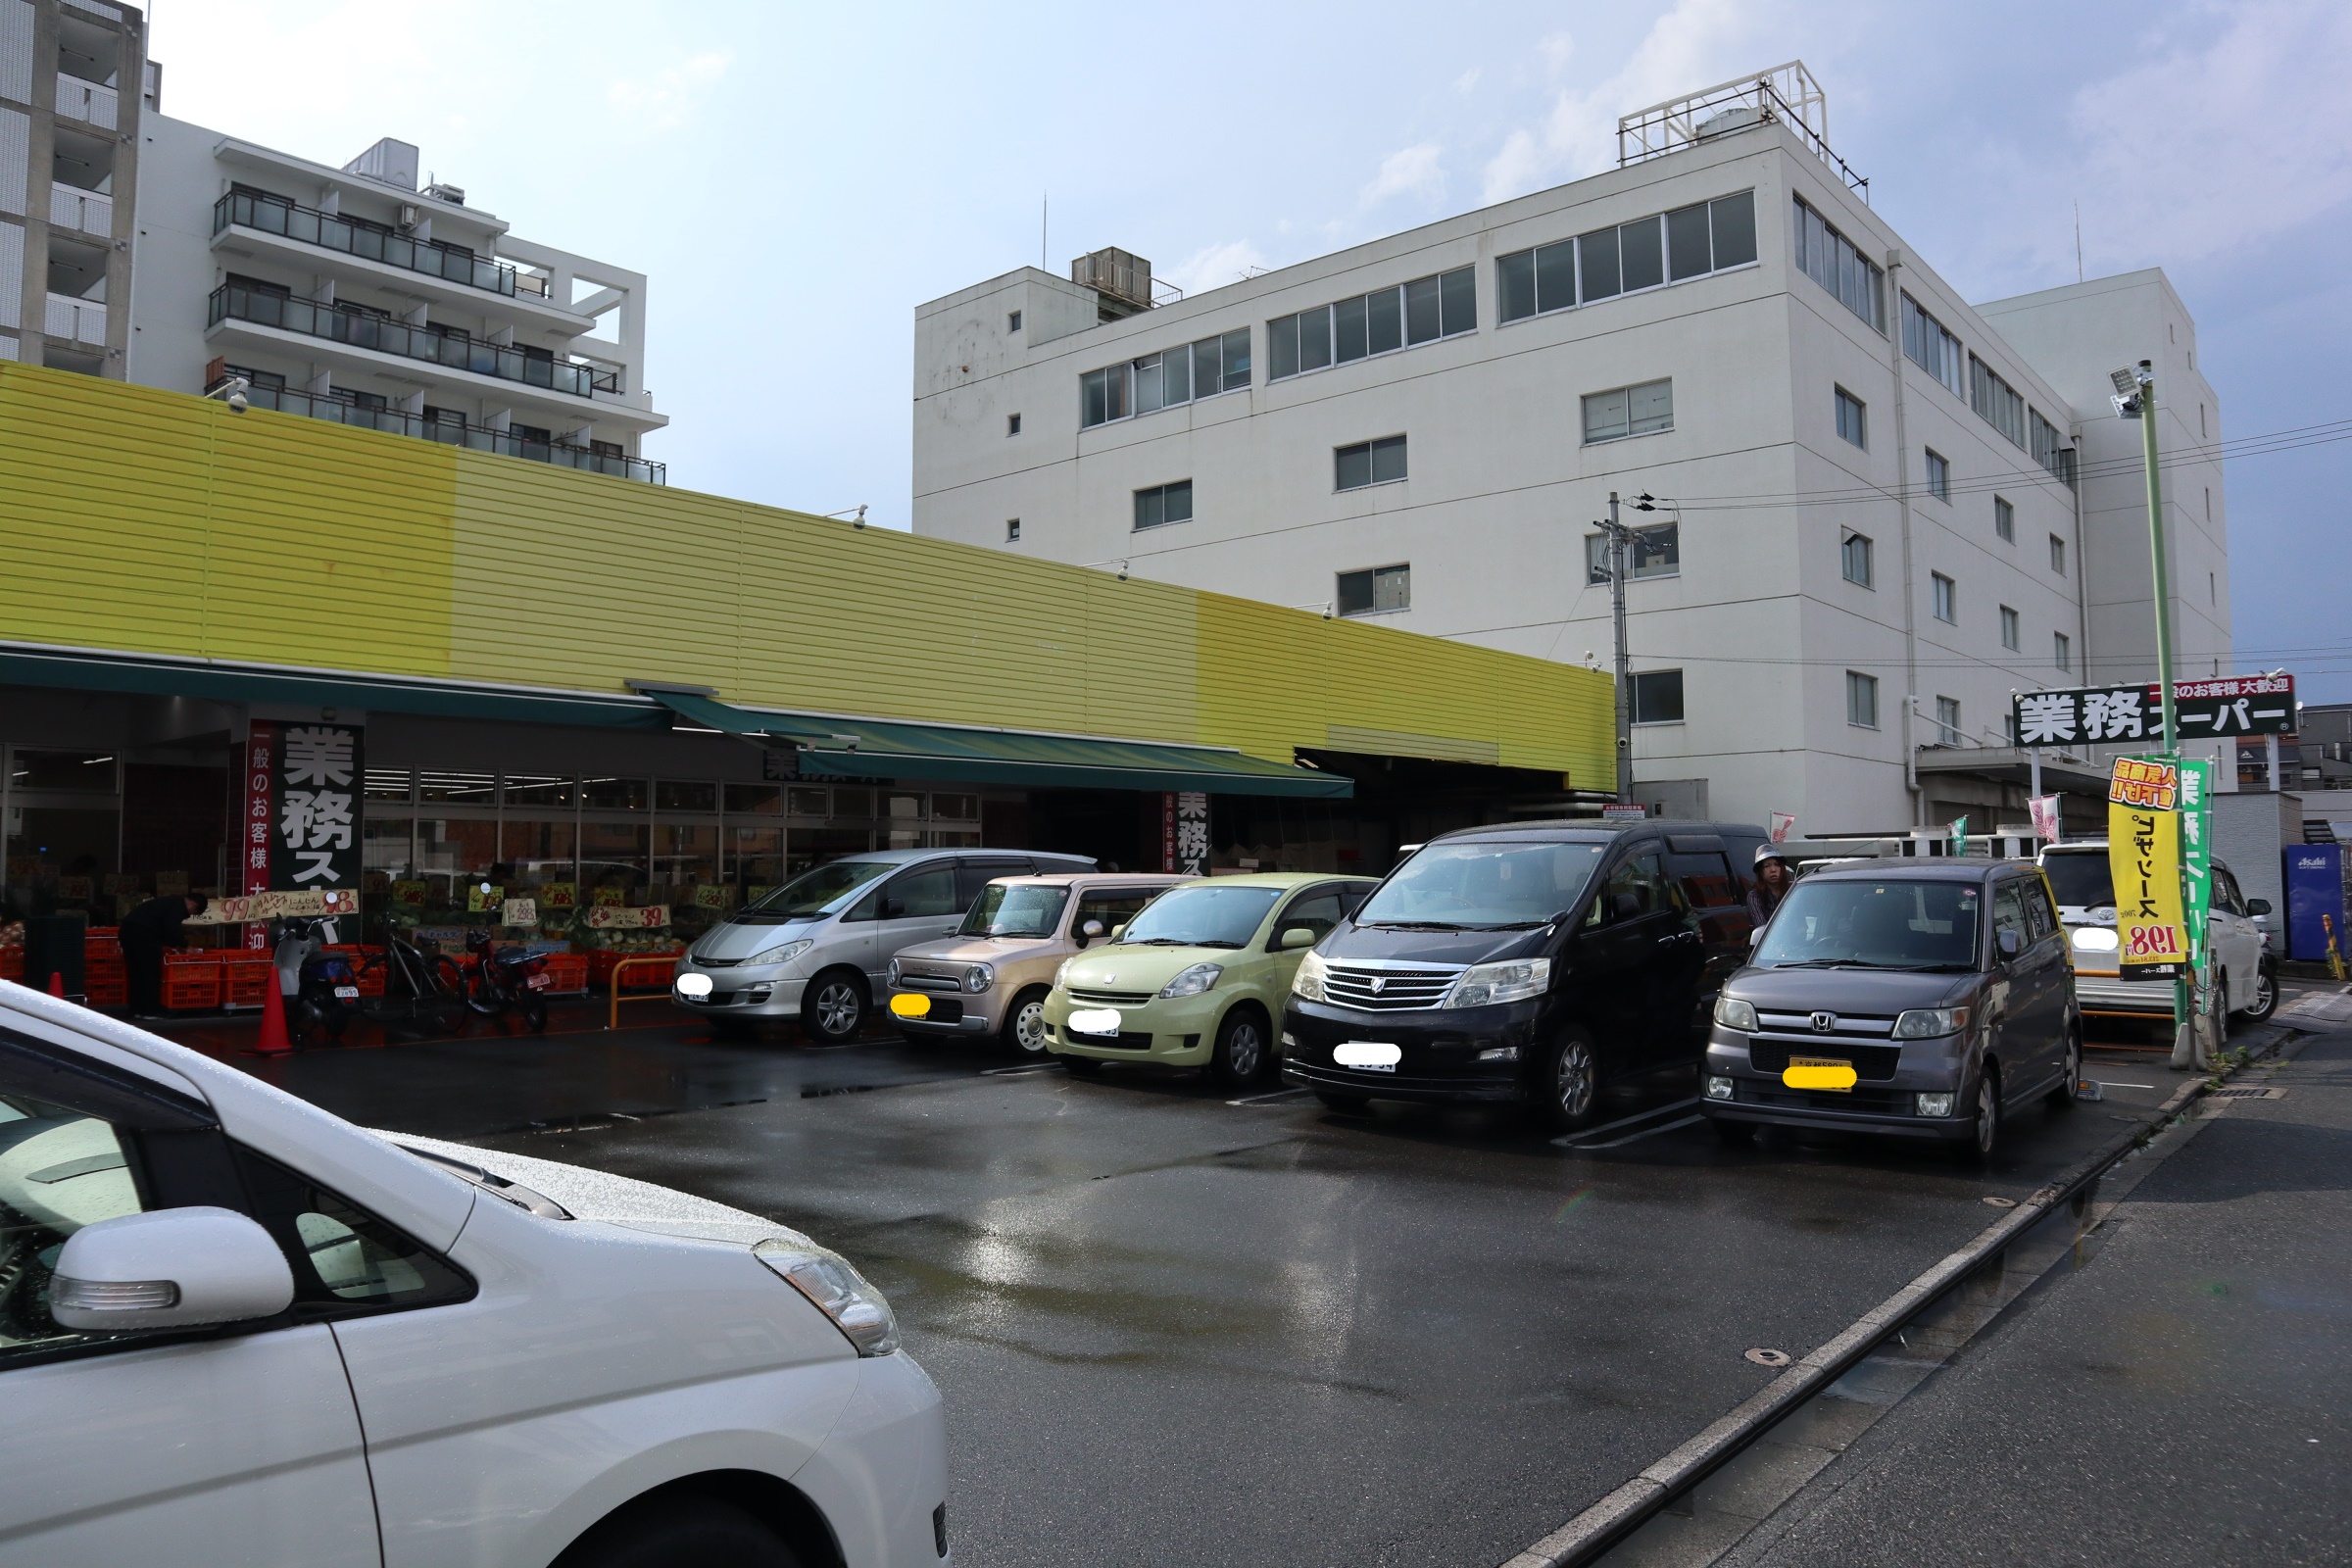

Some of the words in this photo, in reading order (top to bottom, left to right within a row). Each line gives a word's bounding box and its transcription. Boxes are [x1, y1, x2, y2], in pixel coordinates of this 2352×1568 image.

[2241, 678, 2289, 694] 大歓迎
[2019, 690, 2285, 744] 業務スーパー
[251, 733, 270, 869] 一般のお客様
